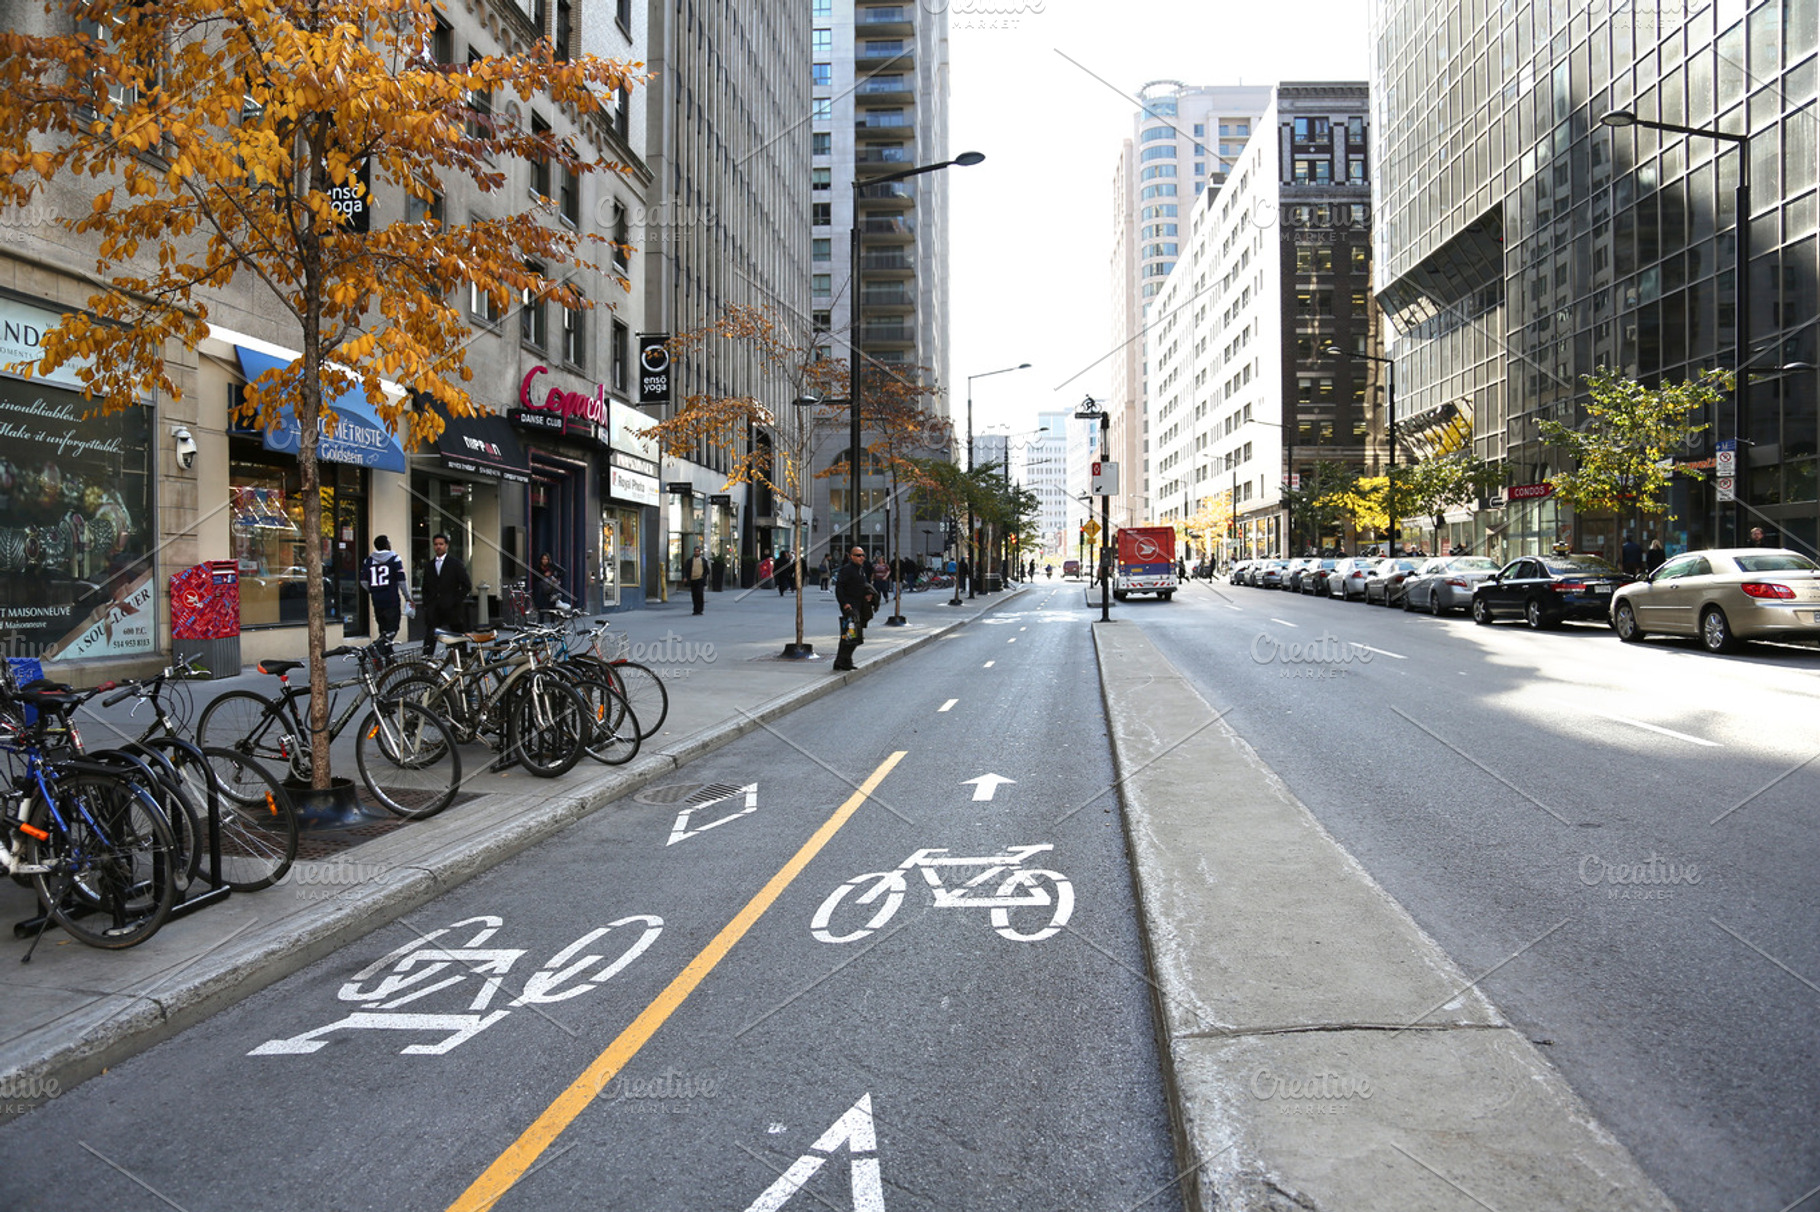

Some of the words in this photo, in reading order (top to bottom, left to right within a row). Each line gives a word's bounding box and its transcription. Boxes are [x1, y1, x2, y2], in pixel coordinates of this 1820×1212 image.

[644, 384, 666, 394] yoga
[521, 413, 544, 425] DANSE
[546, 417, 562, 428] CLUB
[321, 444, 363, 465] Goldstein
[1514, 486, 1545, 497] CONDOS
[370, 565, 390, 586] 12
[8, 606, 71, 618] MAISONNEUVE
[5, 620, 47, 630] Maisonneuve
